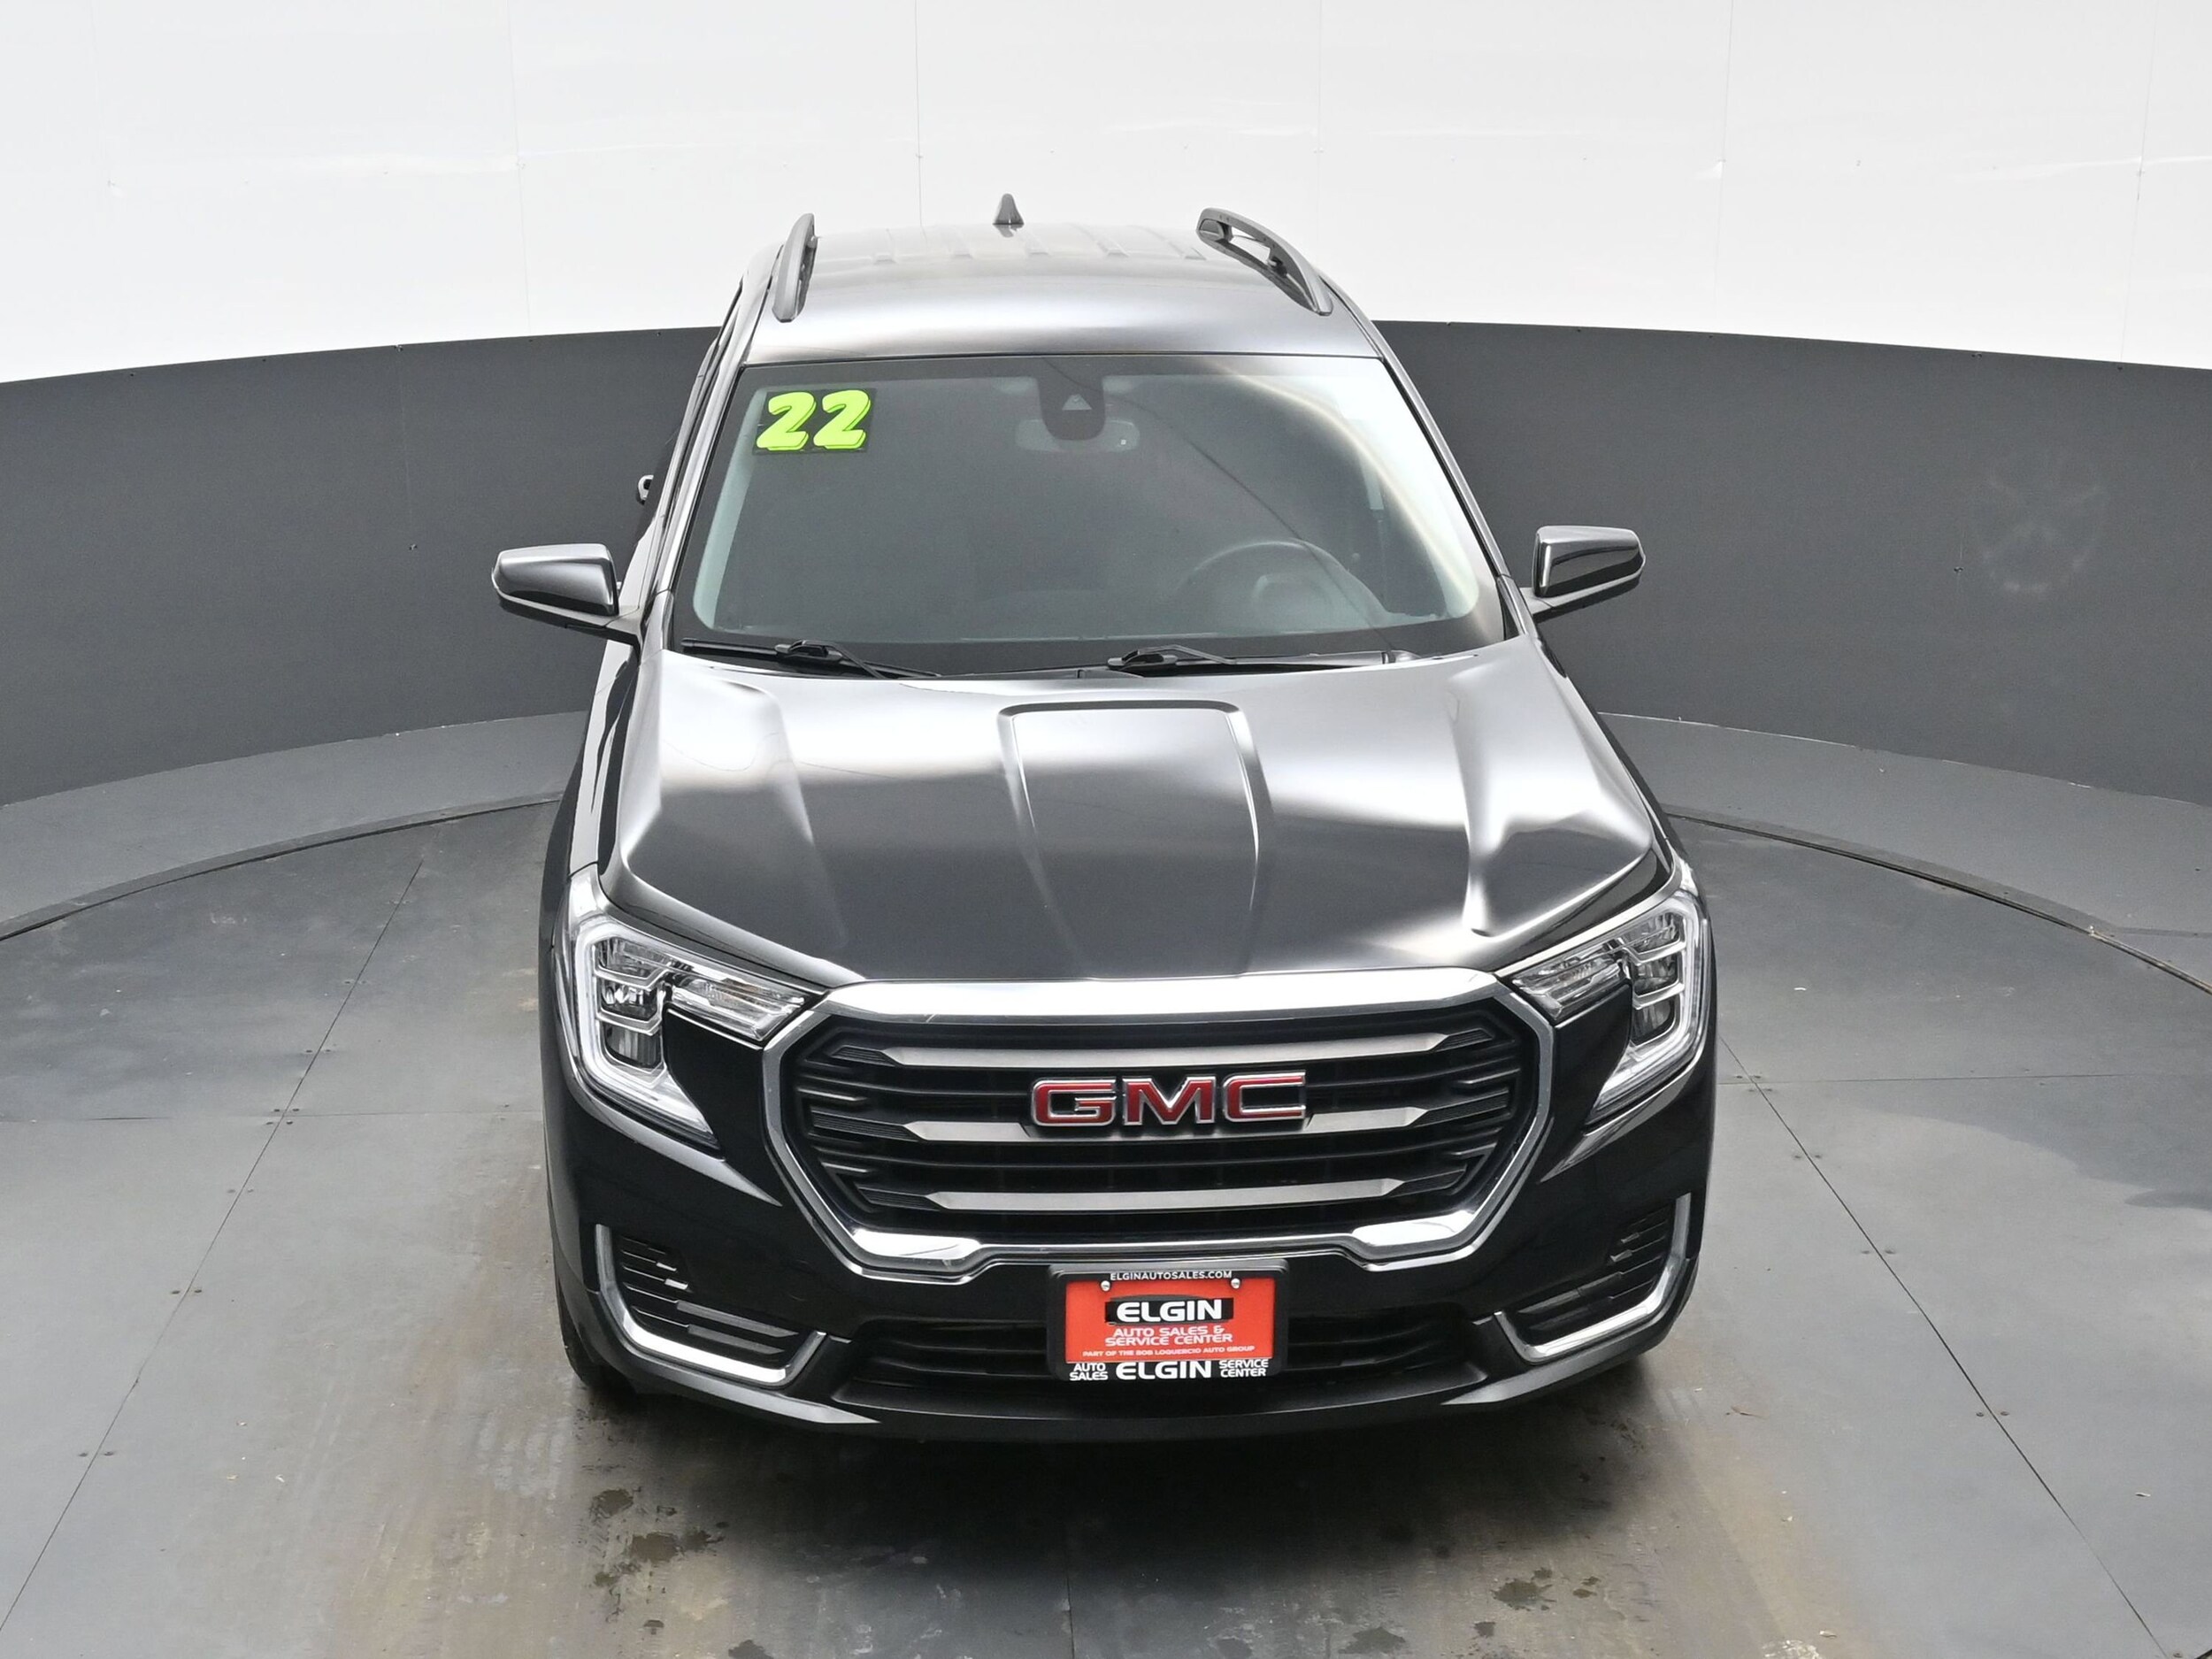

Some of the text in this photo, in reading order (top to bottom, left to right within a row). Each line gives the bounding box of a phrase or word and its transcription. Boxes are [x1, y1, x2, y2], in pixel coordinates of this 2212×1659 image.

[757, 389, 871, 451] 22
[1031, 1071, 1307, 1126] GMC
[1110, 1271, 1233, 1281] ELGINAUTOSALES.COM
[1116, 1299, 1222, 1323] ELGIN
[1112, 1325, 1225, 1338] AUTO SALES &
[1104, 1333, 1233, 1347] SERVICE CENTER
[1072, 1363, 1106, 1372] AUTO
[1116, 1360, 1212, 1380] ELGIN
[1218, 1359, 1269, 1369] SERVICE
[1069, 1371, 1109, 1381] SALES
[1220, 1368, 1266, 1378] CENTER
